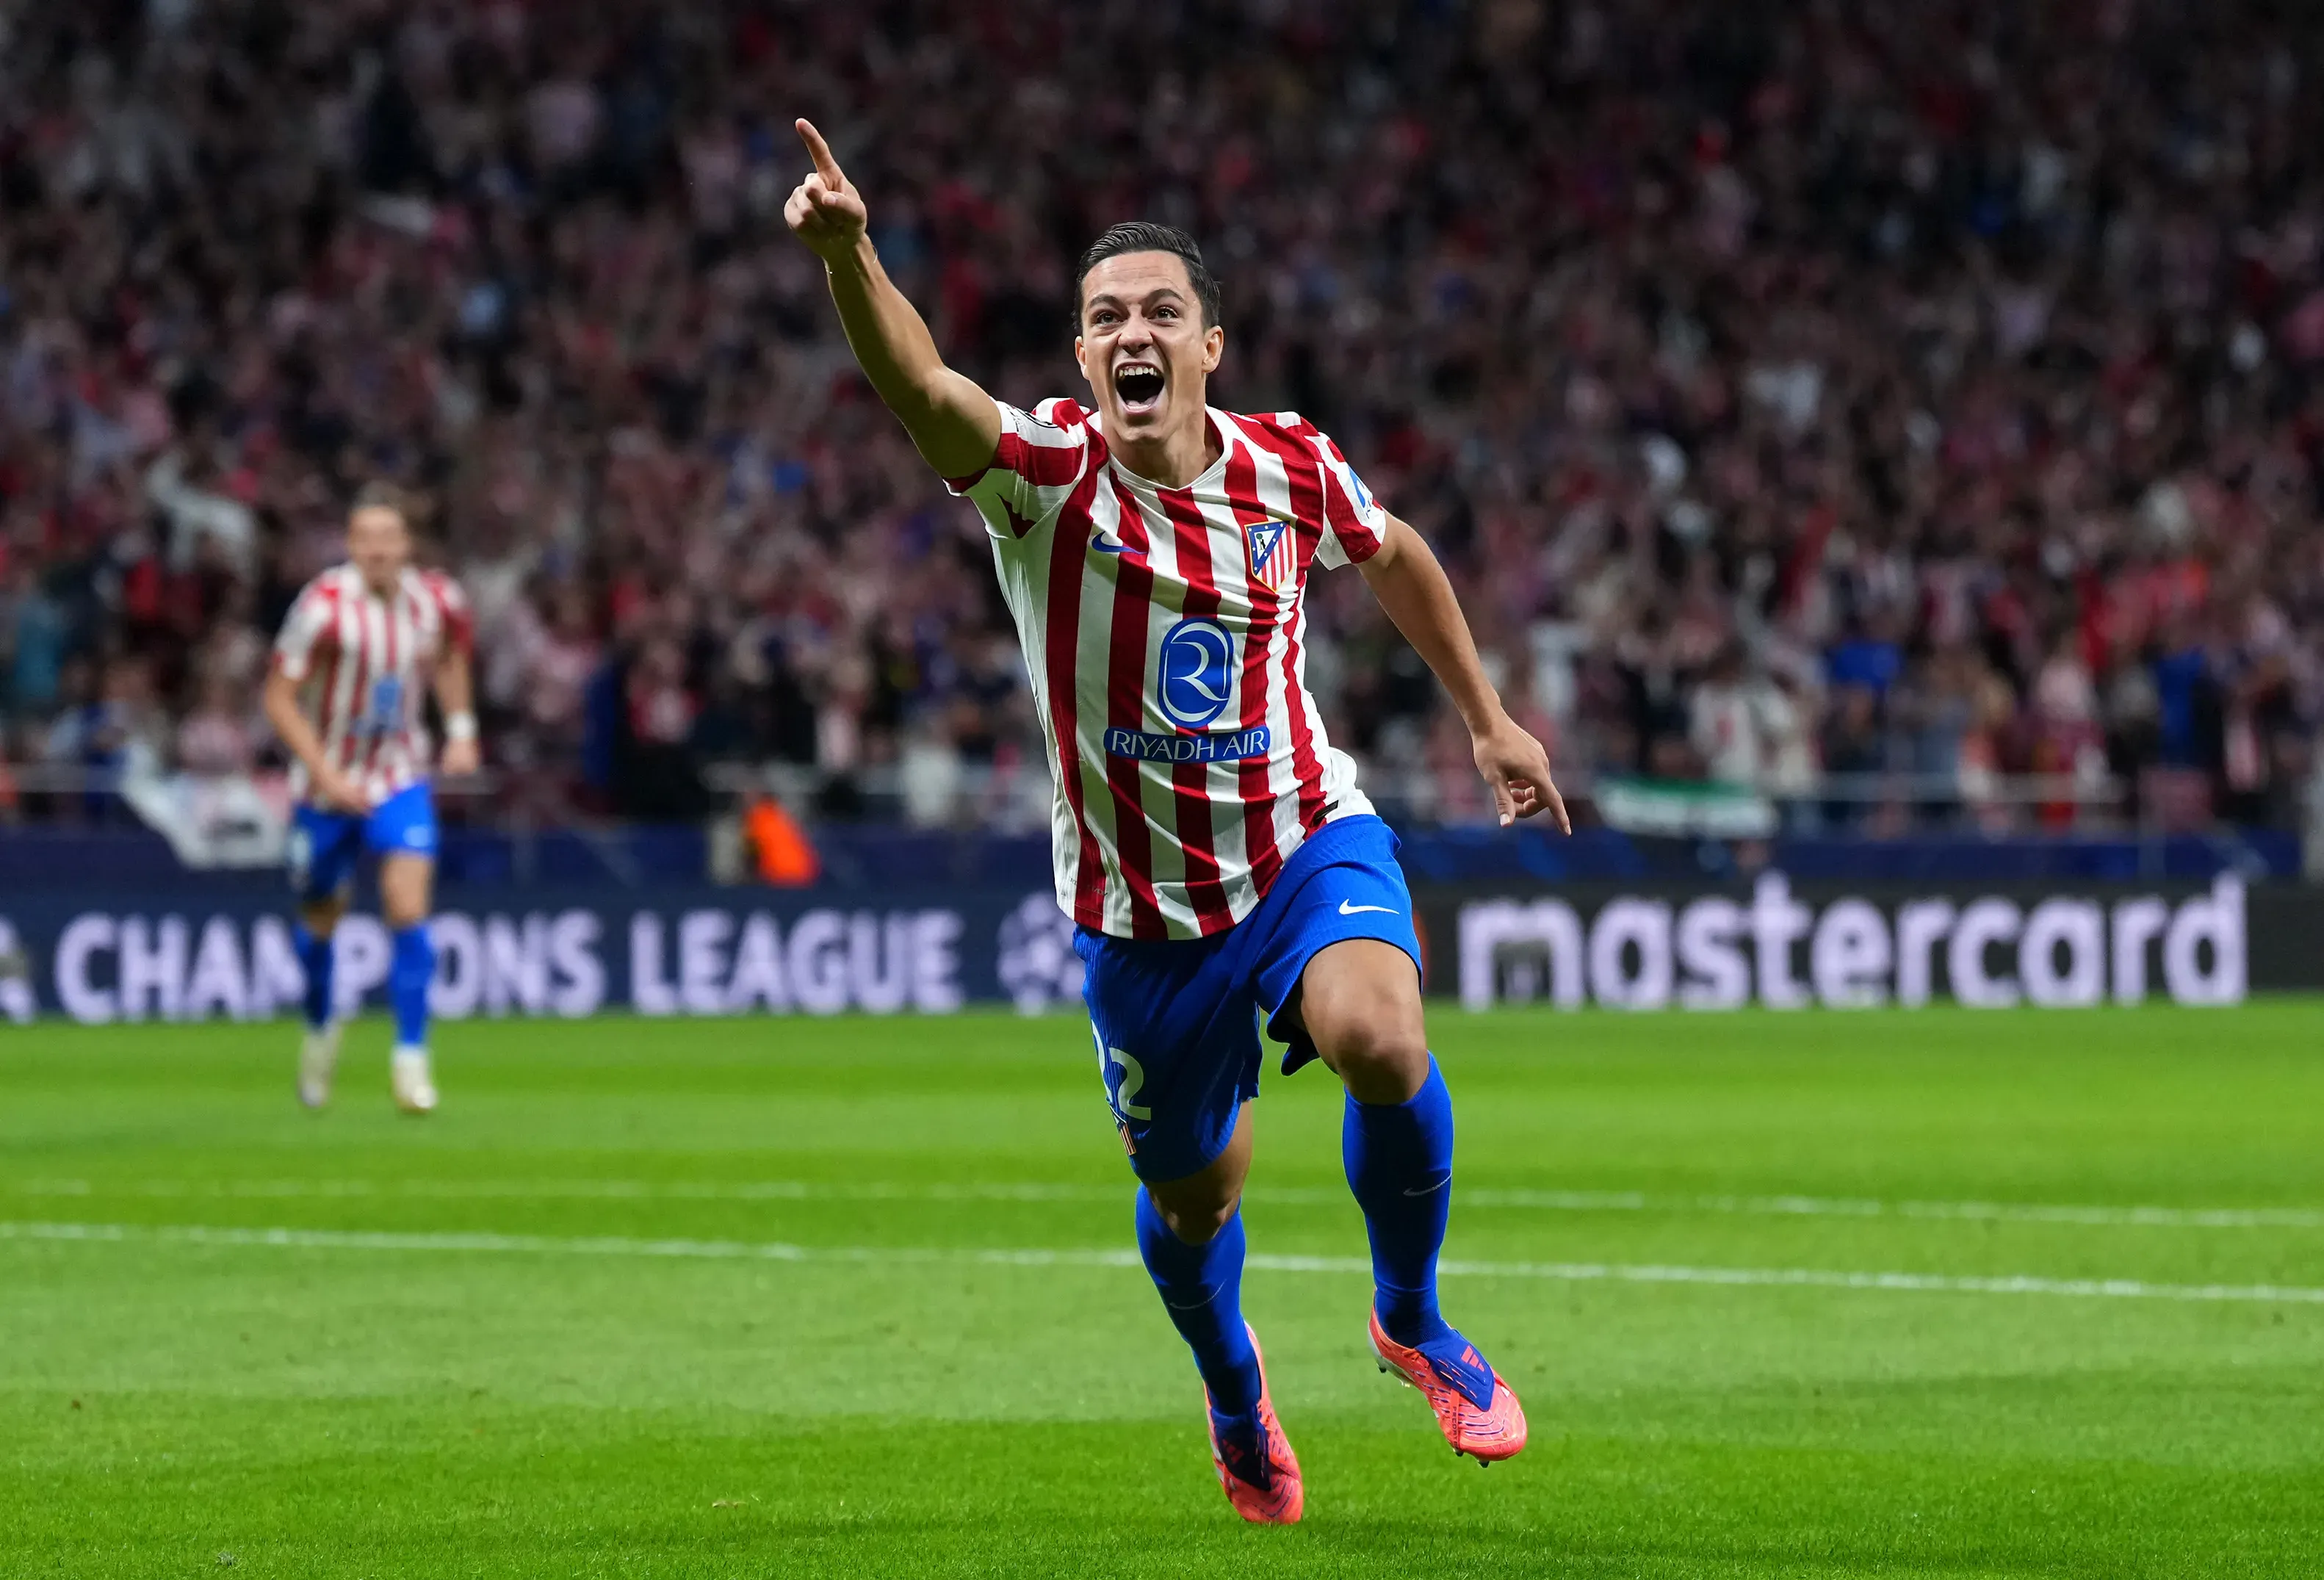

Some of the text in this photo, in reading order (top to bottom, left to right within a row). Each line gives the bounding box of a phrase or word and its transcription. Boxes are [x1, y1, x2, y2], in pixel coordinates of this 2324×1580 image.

[1111, 729, 1265, 760] RIYADH AIR
[56, 909, 962, 1021] CHAMPONS LEAGUE
[1459, 870, 2248, 1011] mastercard
